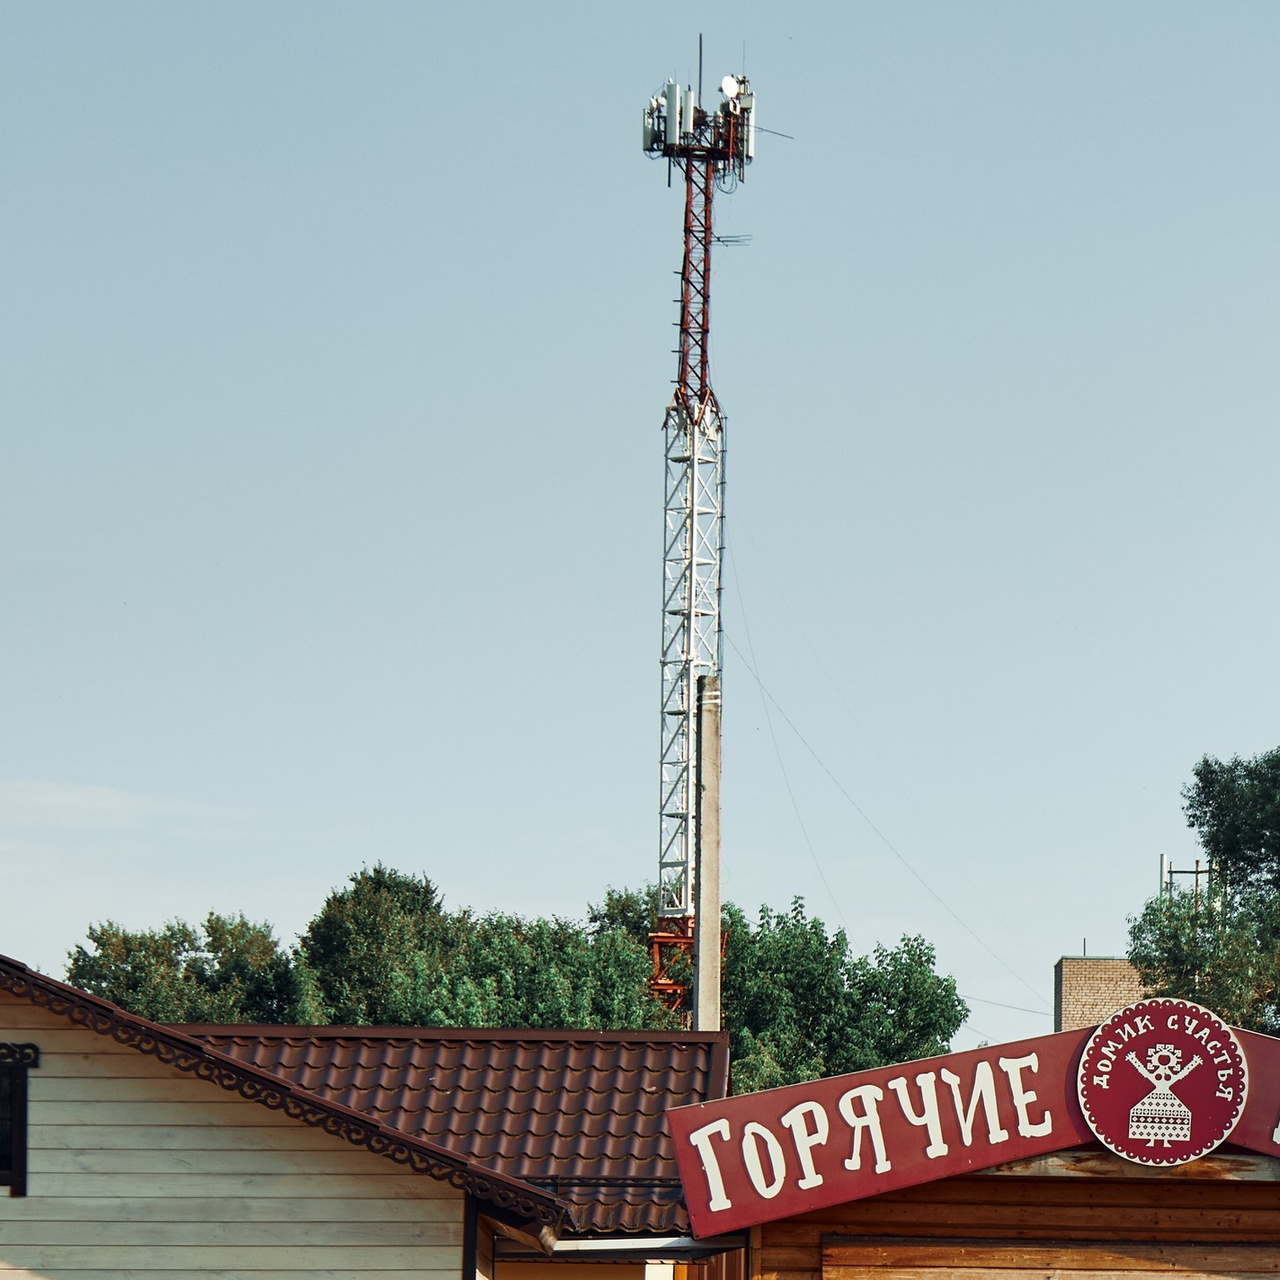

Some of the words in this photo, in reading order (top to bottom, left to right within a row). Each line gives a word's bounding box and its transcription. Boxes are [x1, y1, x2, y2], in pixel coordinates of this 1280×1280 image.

[1093, 1014, 1155, 1089] ДОМИК
[1167, 1014, 1234, 1102] СЧАСТЬЯ
[689, 1052, 1053, 1212] ГОРЯЧИЕ
